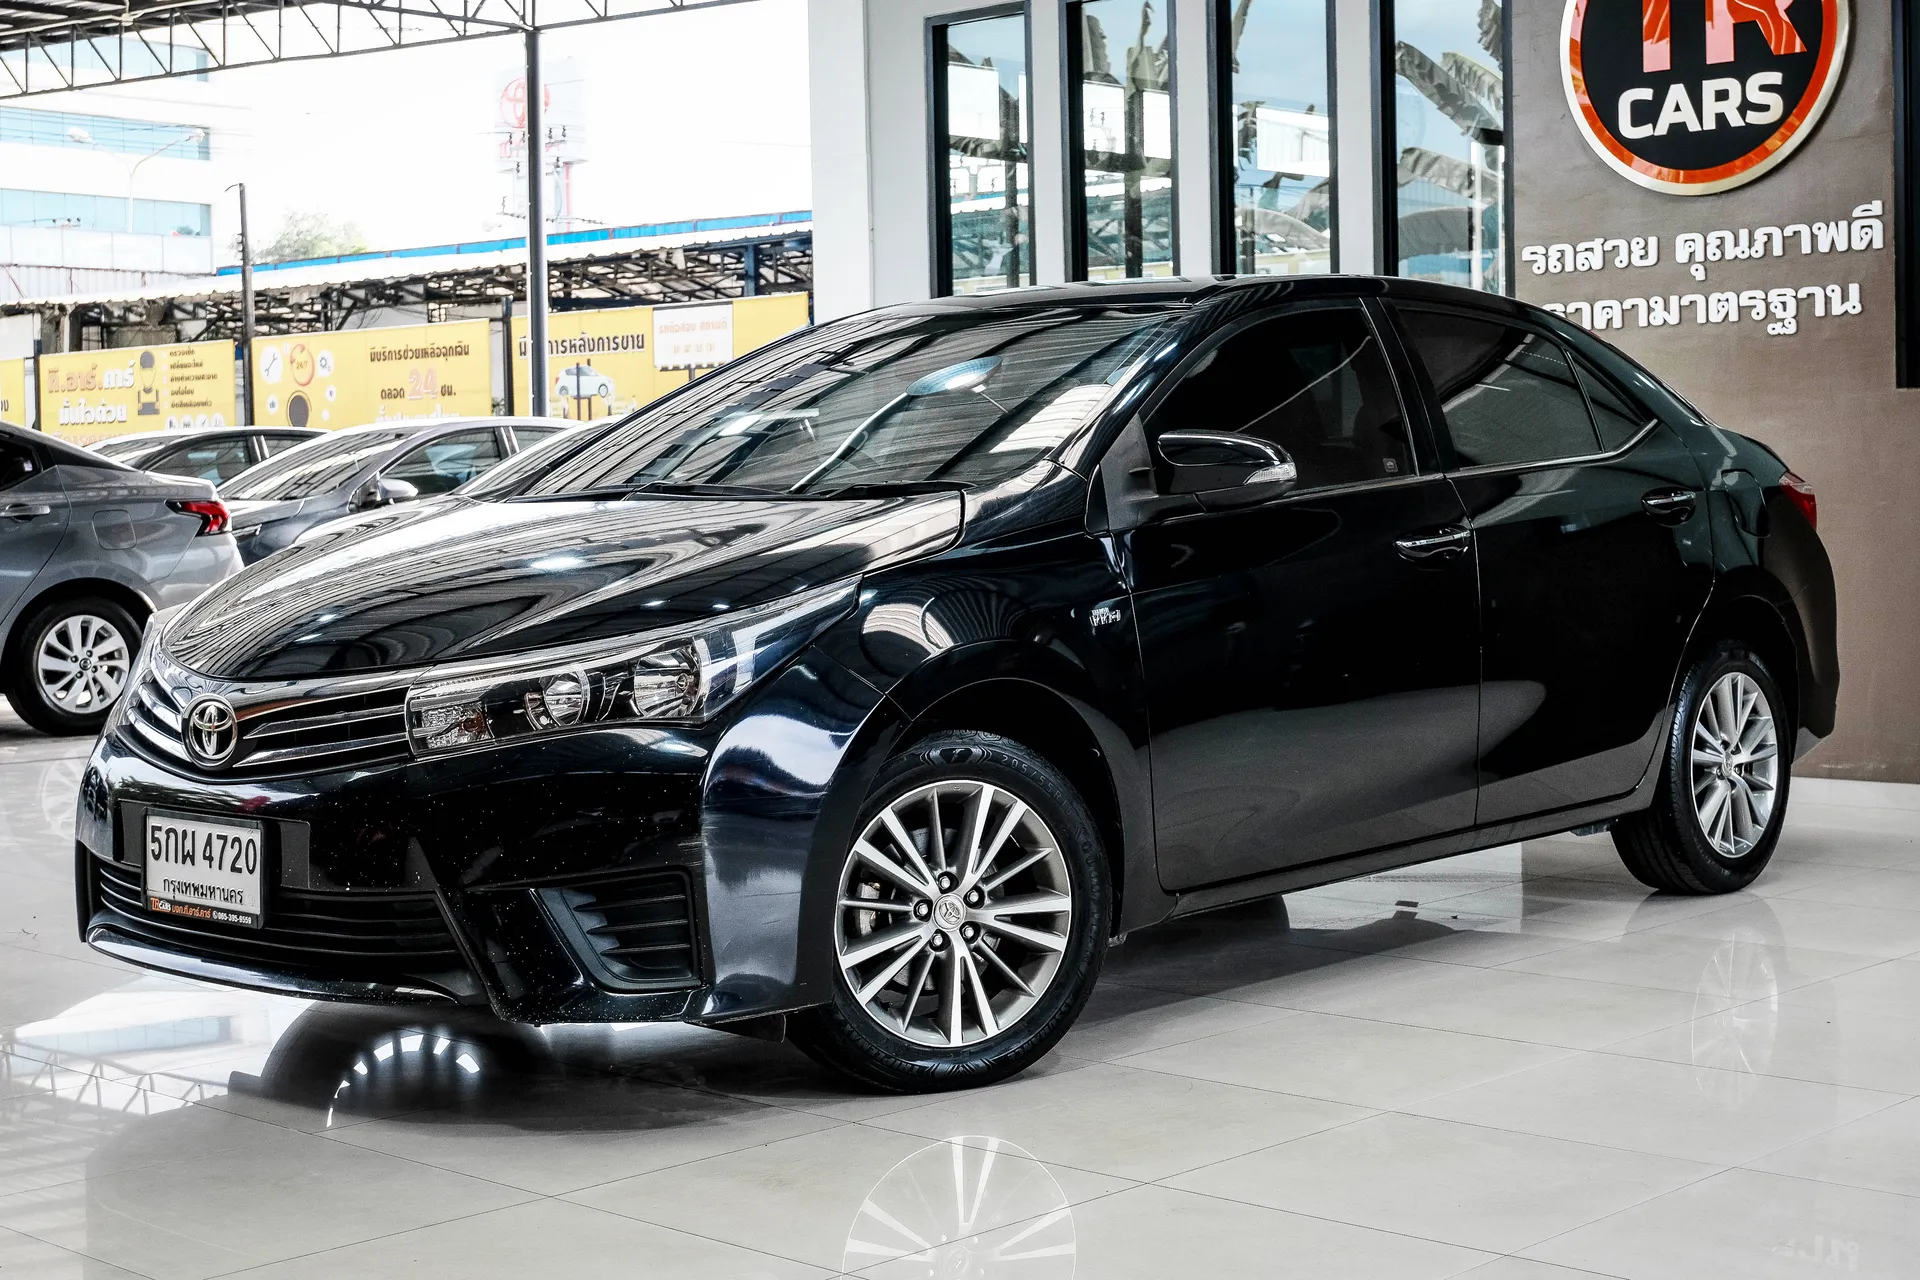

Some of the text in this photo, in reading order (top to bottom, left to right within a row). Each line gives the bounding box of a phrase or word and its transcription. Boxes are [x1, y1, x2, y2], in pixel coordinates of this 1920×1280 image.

[1617, 71, 1784, 140] CARS
[1521, 200, 1884, 281] รถสวย คุณภาพดี
[370, 341, 470, 363] มีบริการช่วยเหลือฉุกเฉิน
[380, 388, 406, 400] ตลอด
[407, 366, 438, 401] 24
[1001, 754, 1073, 816] 205/55R16
[150, 824, 258, 875] 5กผ 4720
[163, 877, 244, 905] กรุงเทพมหานคร
